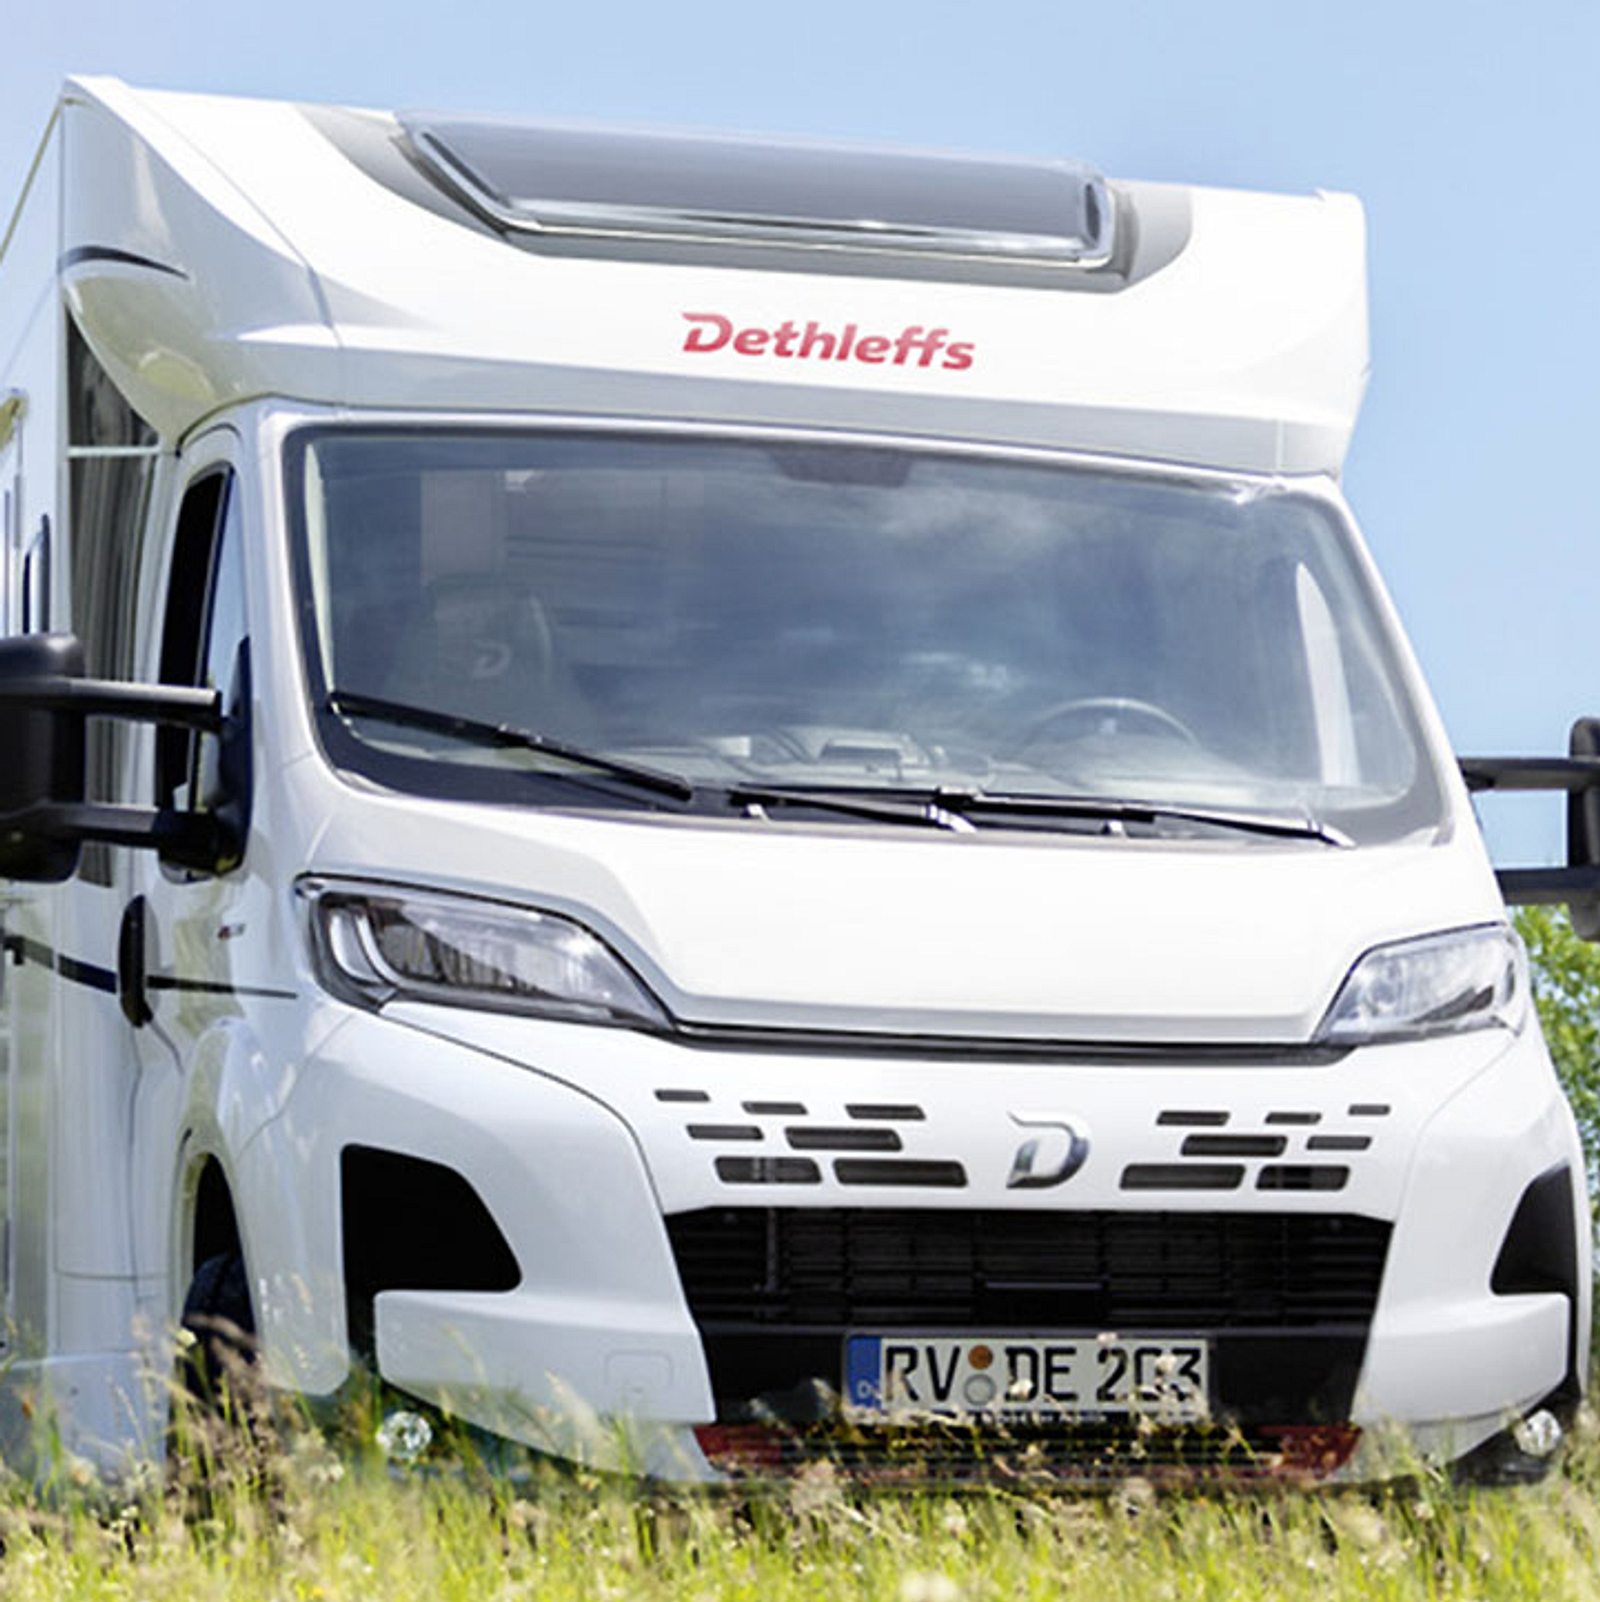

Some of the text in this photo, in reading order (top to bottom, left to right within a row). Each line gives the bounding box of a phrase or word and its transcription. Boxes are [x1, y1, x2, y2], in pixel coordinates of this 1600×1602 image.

[681, 311, 975, 370] Dethleffs
[1006, 1110, 1090, 1189] D
[886, 1346, 961, 1401] RV
[1004, 1346, 1078, 1401] DE
